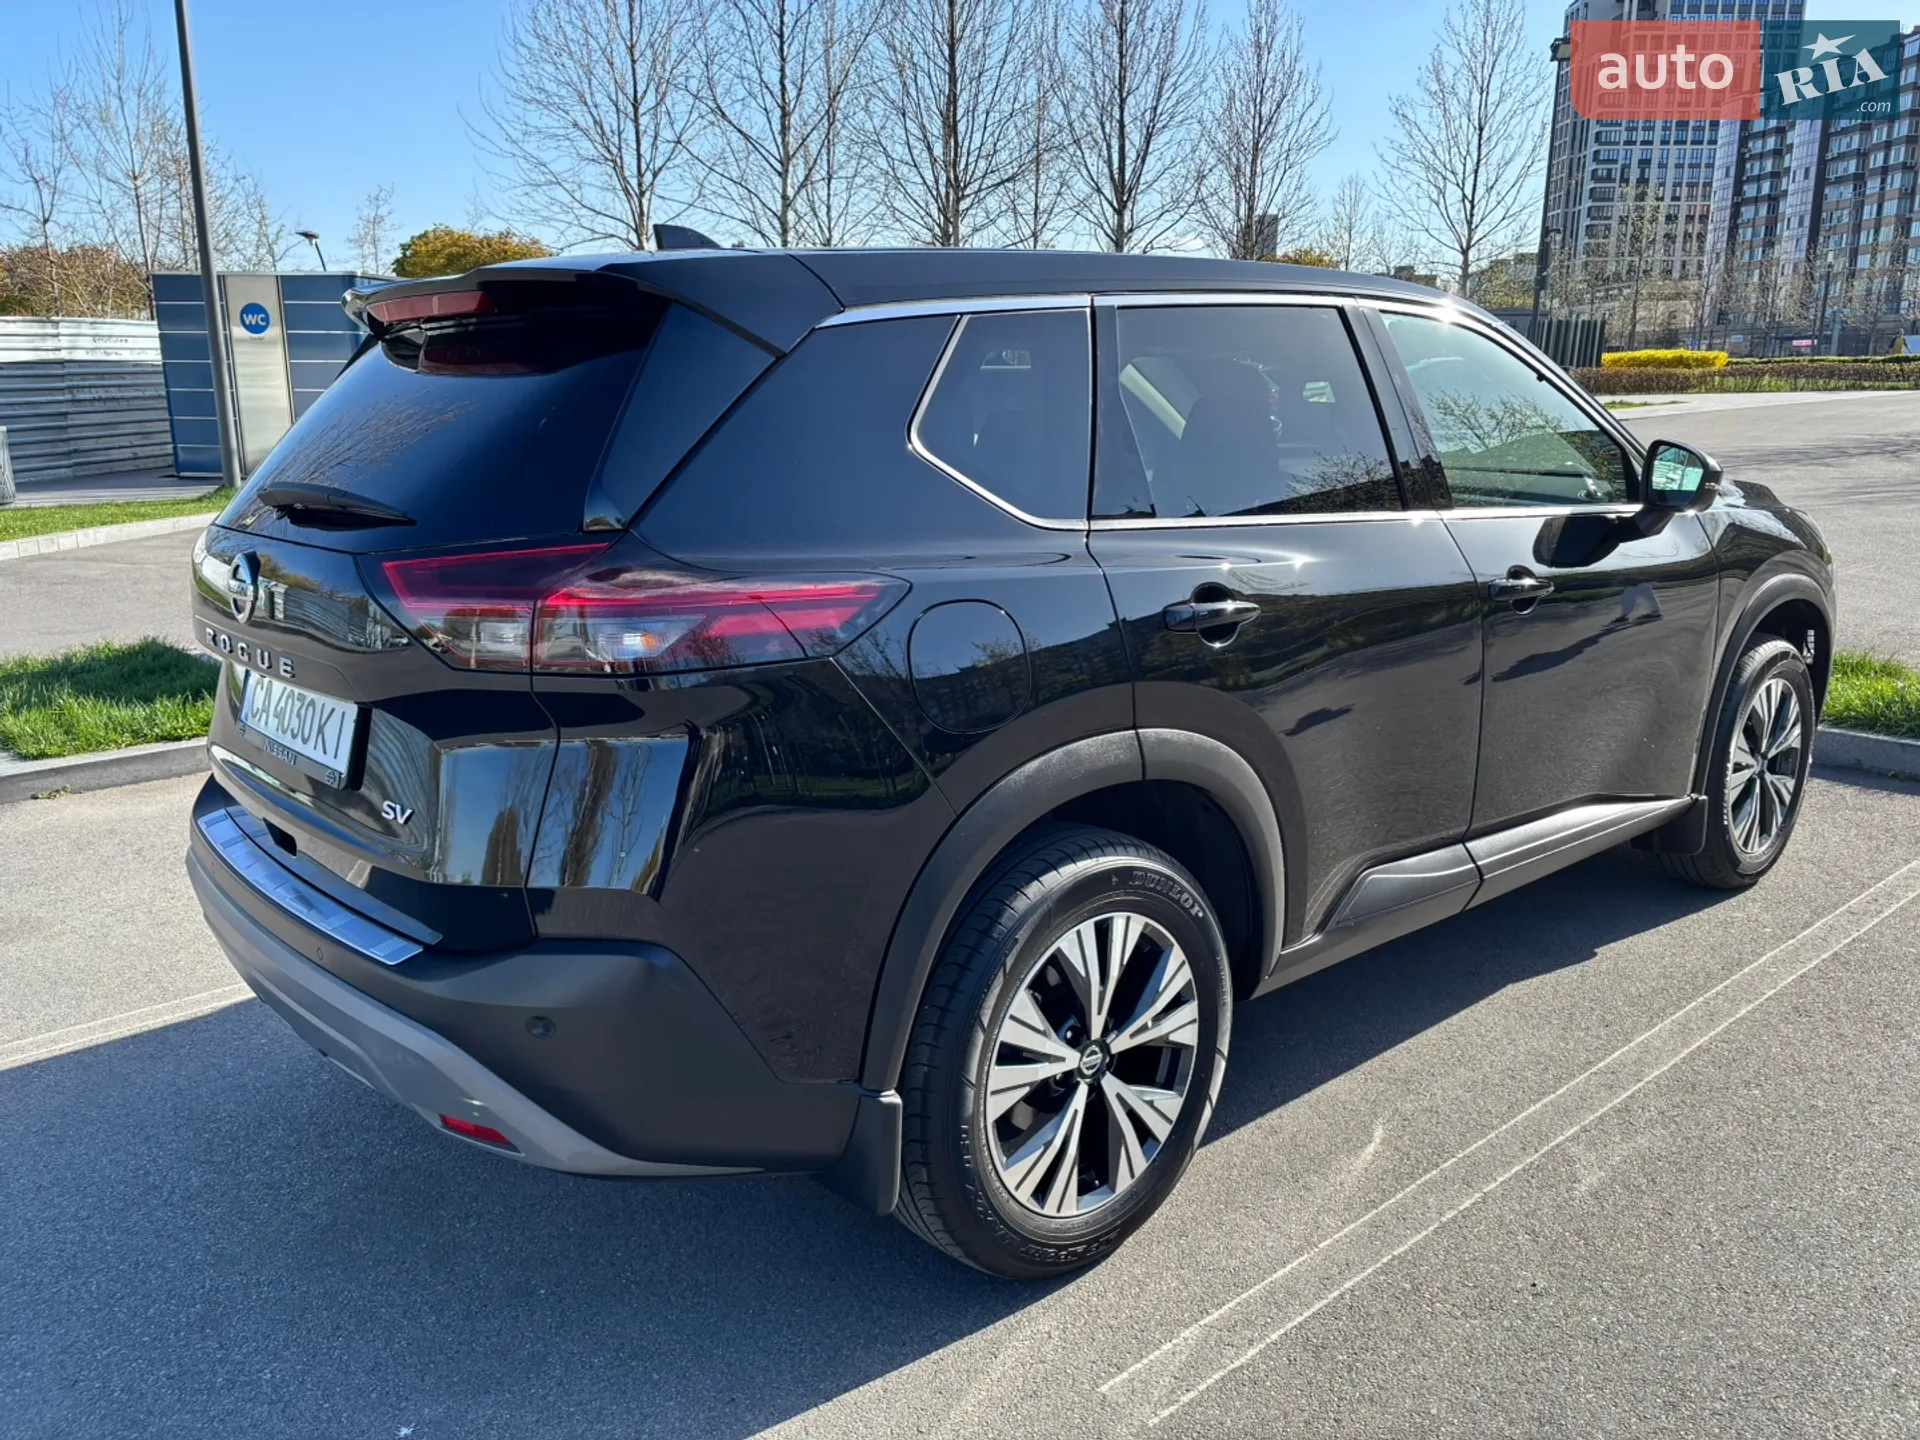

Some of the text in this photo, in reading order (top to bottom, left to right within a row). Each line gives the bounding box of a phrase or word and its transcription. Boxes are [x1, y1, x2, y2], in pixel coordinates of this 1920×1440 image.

[242, 313, 267, 326] WC
[205, 627, 296, 679] ROGUE
[381, 800, 414, 825] SV
[1129, 870, 1204, 918] DUNLOP
